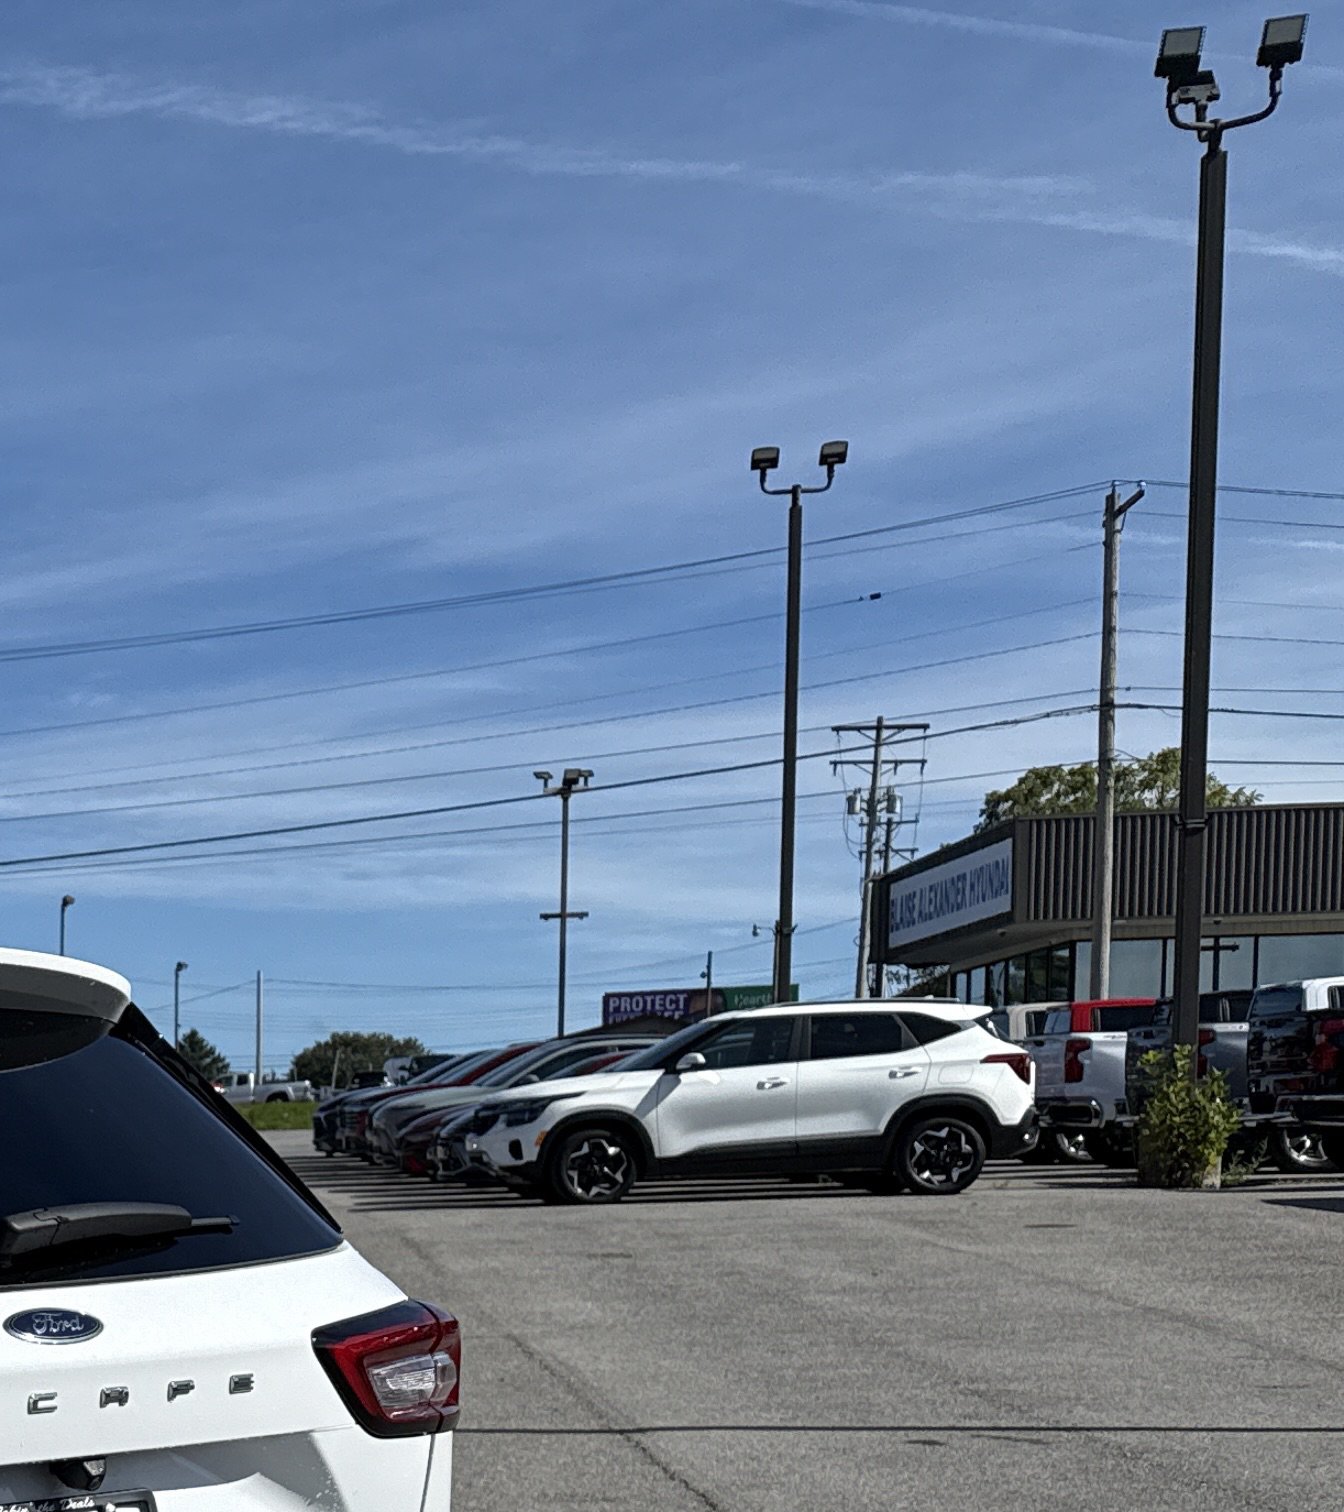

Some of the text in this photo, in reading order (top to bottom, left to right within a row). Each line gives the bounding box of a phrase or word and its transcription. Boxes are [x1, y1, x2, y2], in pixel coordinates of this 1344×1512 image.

[917, 872, 968, 924] ALEXANDER
[969, 854, 1010, 908] HYUNDAI
[608, 993, 688, 1013] PROTECT
[32, 1312, 84, 1335] Ford
